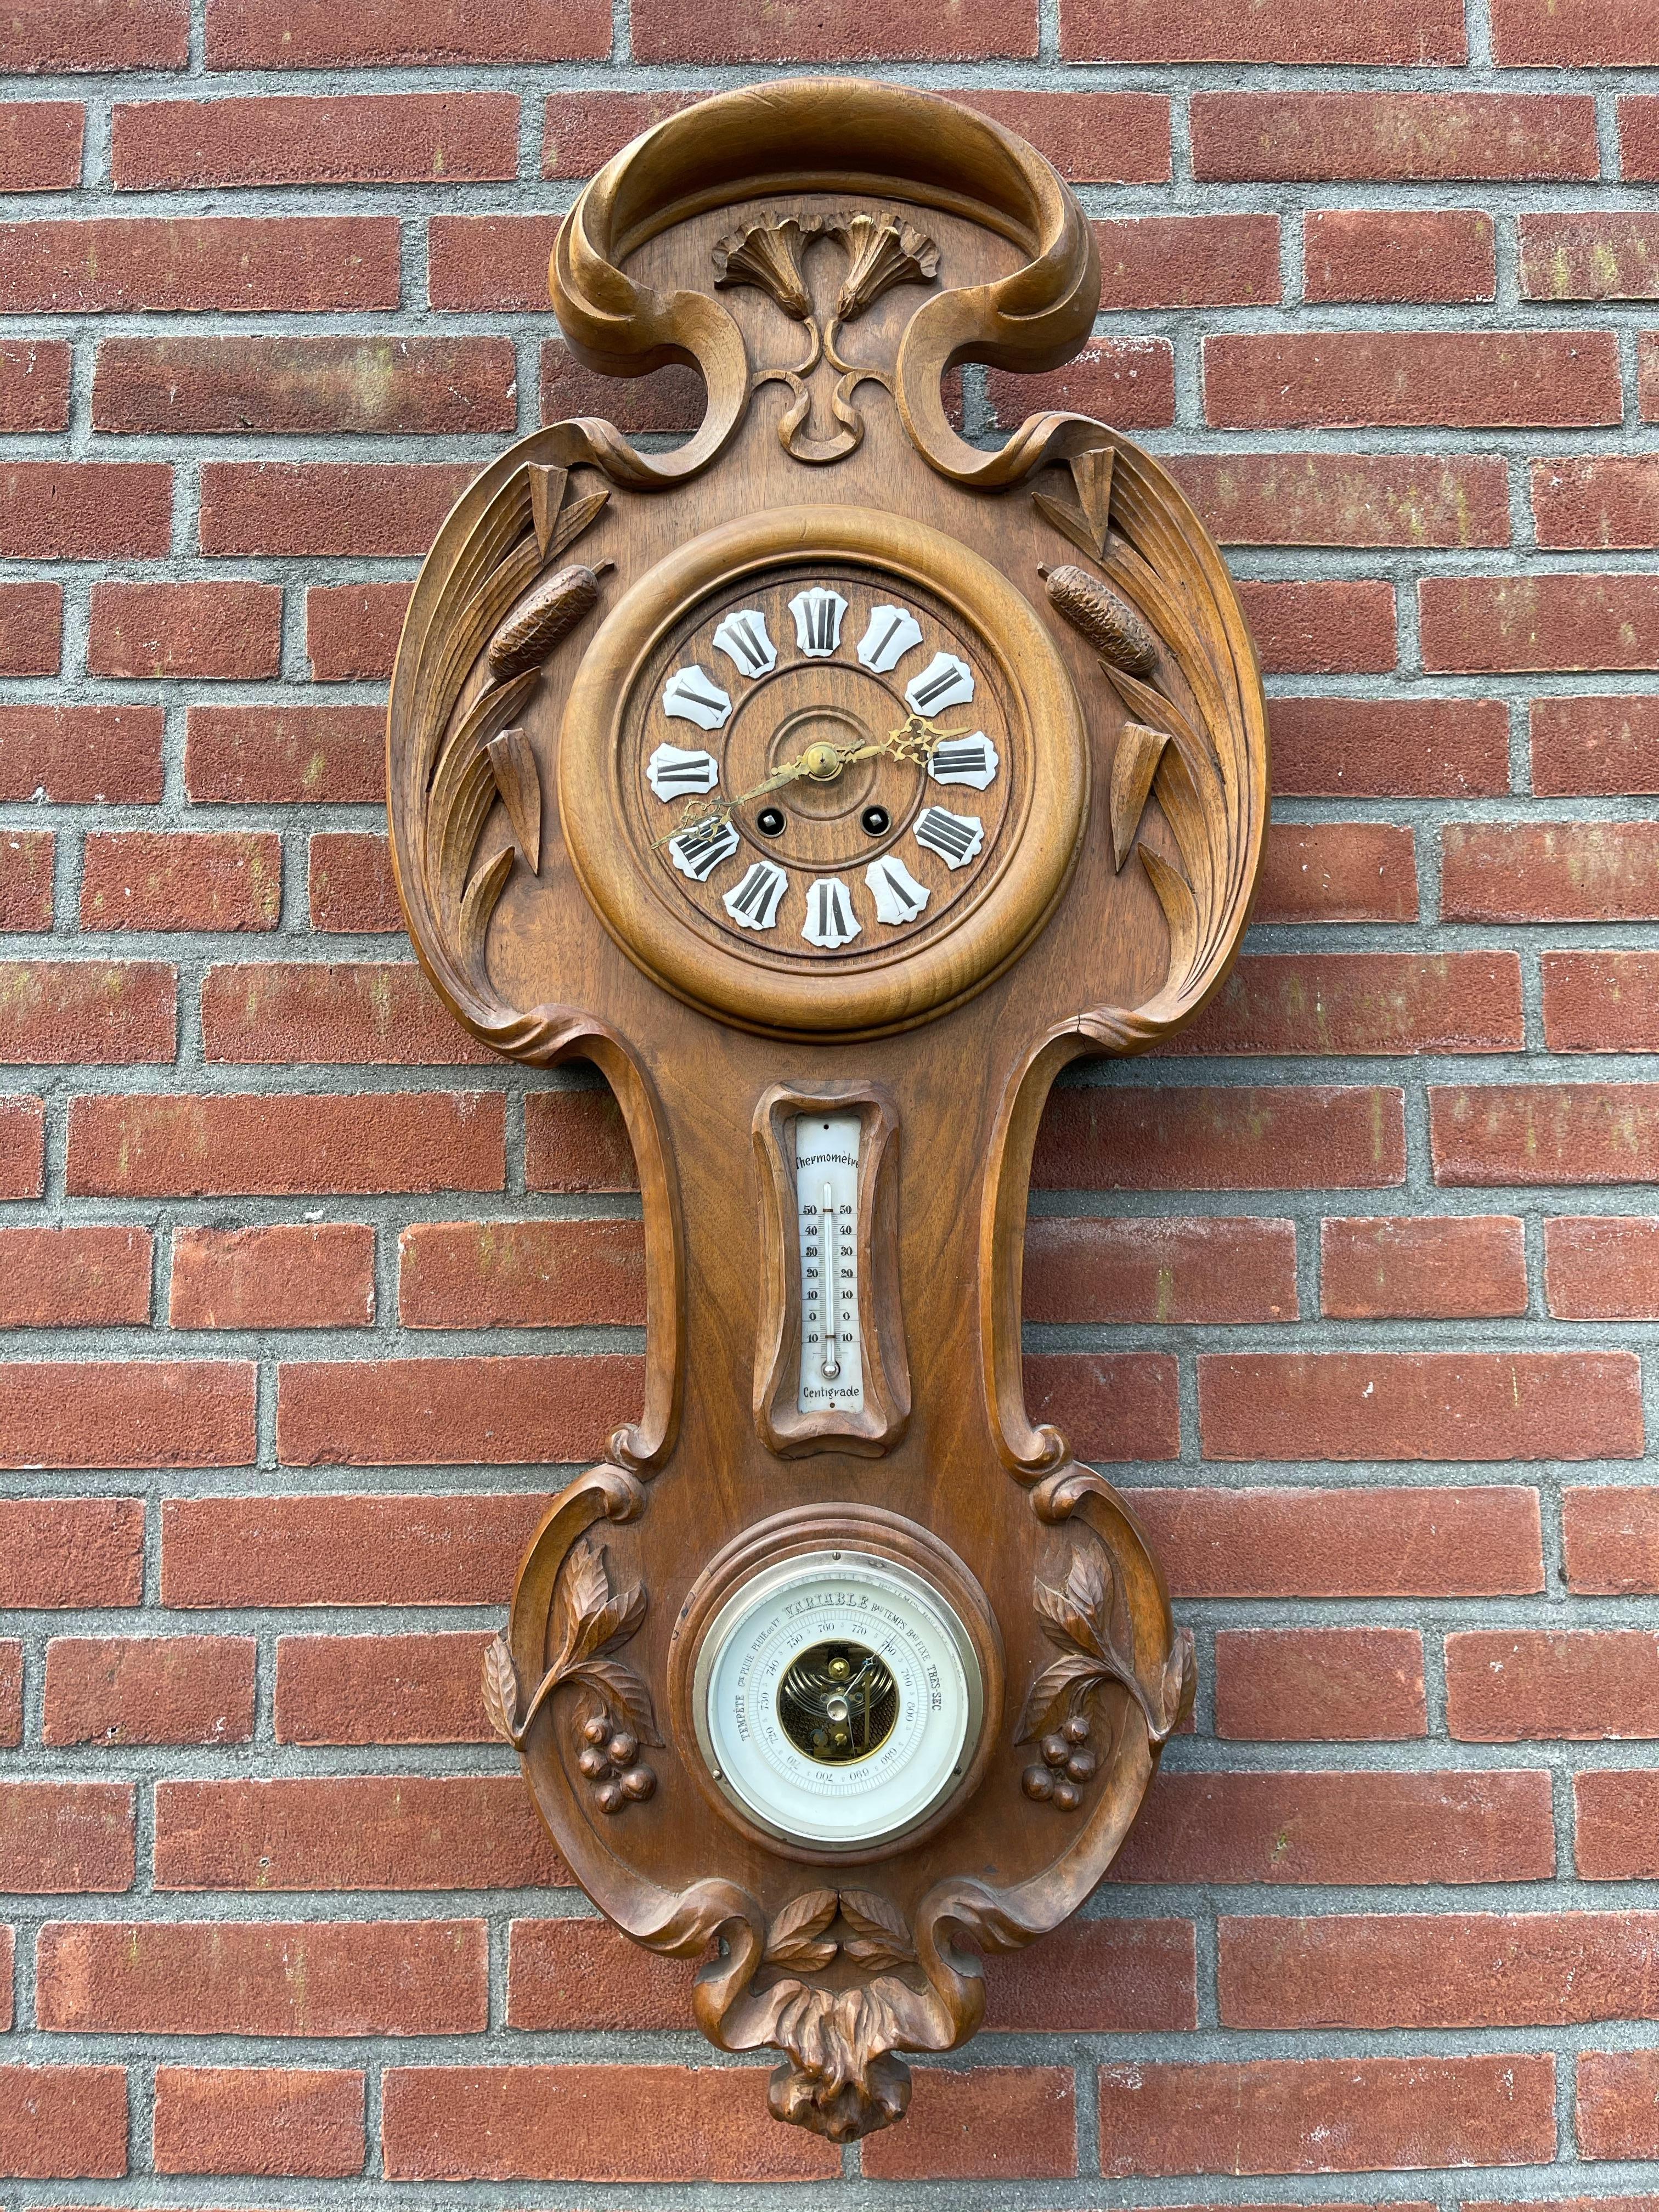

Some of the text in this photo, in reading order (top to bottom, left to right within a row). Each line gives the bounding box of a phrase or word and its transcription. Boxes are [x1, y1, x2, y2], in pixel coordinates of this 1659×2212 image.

[799, 598, 839, 650] XII
[722, 617, 771, 675] XI
[870, 616, 904, 664] I
[910, 663, 967, 712] II
[673, 679, 729, 721] X
[932, 744, 987, 777] III
[657, 757, 710, 783] IX
[922, 806, 979, 862] IIII
[732, 865, 780, 925] VII
[882, 867, 922, 917] V
[816, 883, 850, 938] VI
[803, 1205, 852, 1215] 50 50
[805, 1226, 852, 1235] 40 40
[806, 1246, 853, 1256] 30 30
[806, 1268, 853, 1278] 20 20
[807, 1290, 853, 1299] 10 10
[809, 1312, 850, 1321] 0 0
[808, 1333, 853, 1342] 10 10
[803, 1385, 859, 1399] Centigrade
[741, 1653, 754, 1675] PLUIE
[751, 1631, 768, 1652] PLUIE
[784, 1592, 869, 1618] VARIABLE
[883, 1609, 907, 1630] TEMPS
[916, 1641, 931, 1662] FIXE
[817, 1622, 834, 1633] 760
[851, 1624, 867, 1635] 770
[786, 1634, 803, 1649] 750
[766, 1660, 780, 1677] 740
[901, 1668, 913, 1686] 790
[761, 1692, 769, 1711] 730
[906, 1701, 916, 1722] 800
[766, 1726, 779, 1744] 720
[787, 1756, 801, 1770] 710
[880, 1748, 898, 1765] 680
[816, 1770, 833, 1782] 700
[850, 1768, 869, 1781] 690
